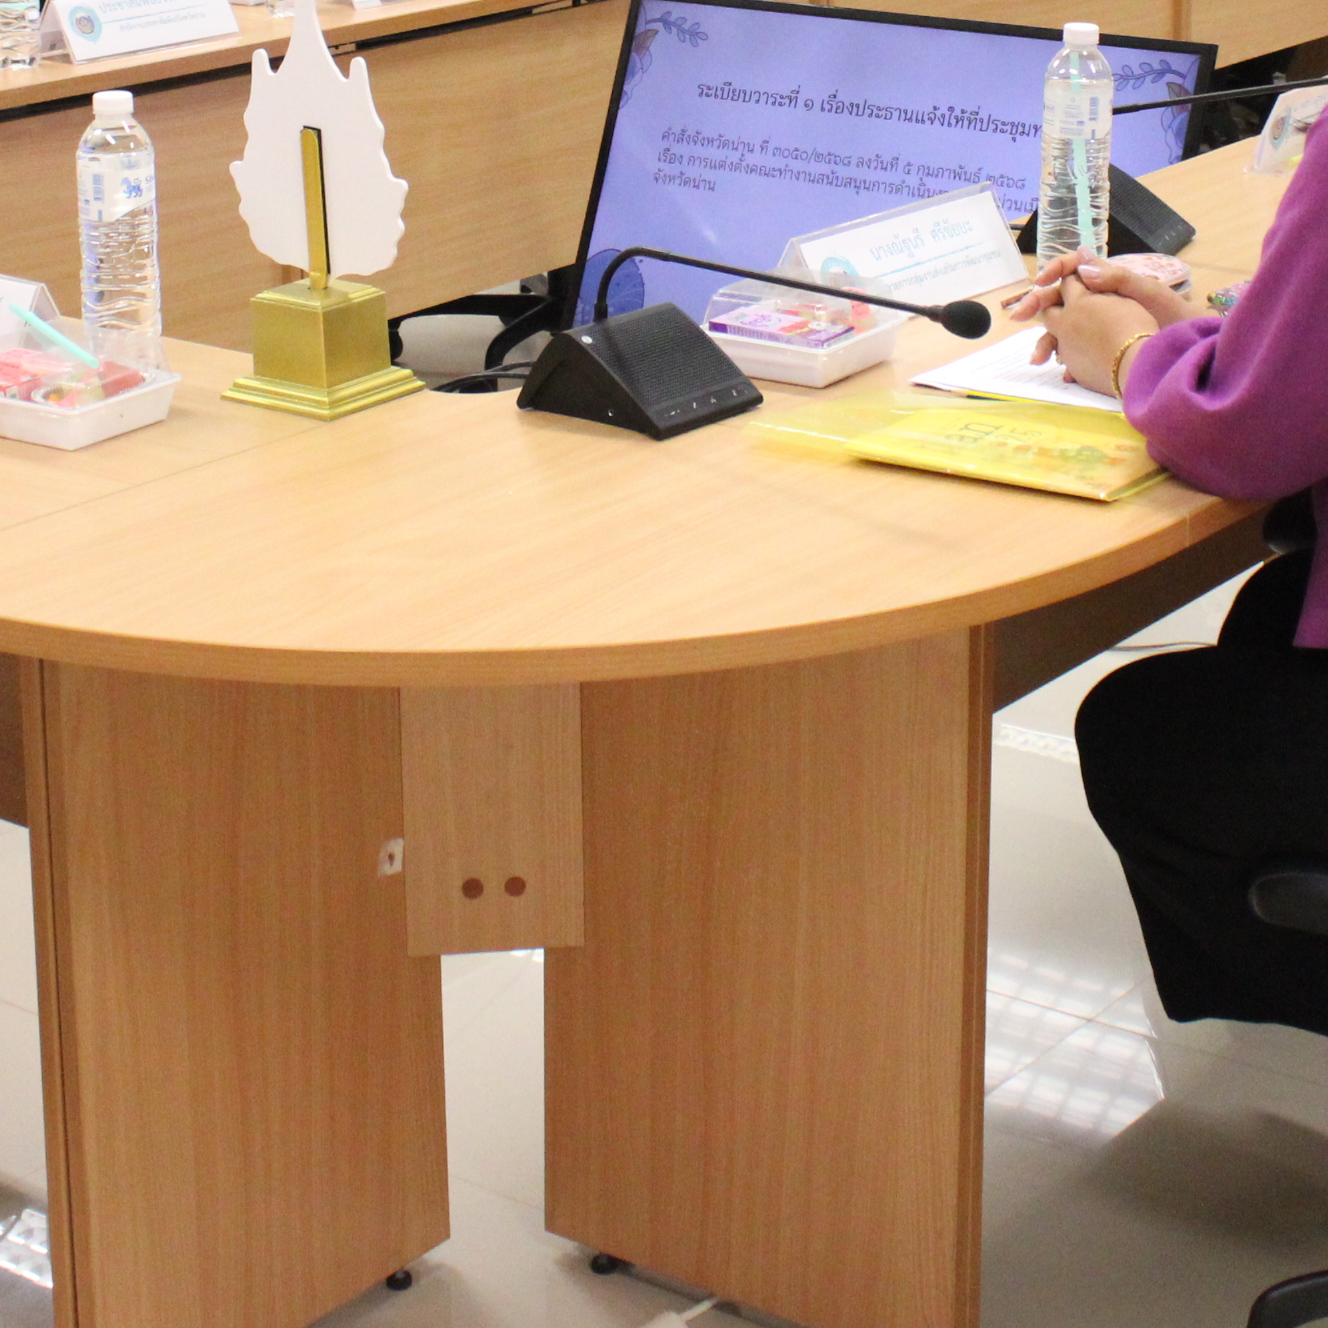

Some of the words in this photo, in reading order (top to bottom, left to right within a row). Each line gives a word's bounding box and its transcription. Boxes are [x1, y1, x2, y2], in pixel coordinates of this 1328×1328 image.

[697, 81, 801, 109] ระเบียบวาระที่
[804, 96, 814, 111] ๑
[657, 144, 684, 165] เรื่อง
[661, 125, 754, 155] คำสั่งจังหวัดน่าน
[759, 136, 771, 156] ที่
[772, 146, 852, 167] ๓๐๕๐/๒๕๖๘
[855, 153, 900, 172] ลงวันที่
[902, 160, 912, 175] ๕
[653, 168, 716, 192] จังหวัดน่าน
